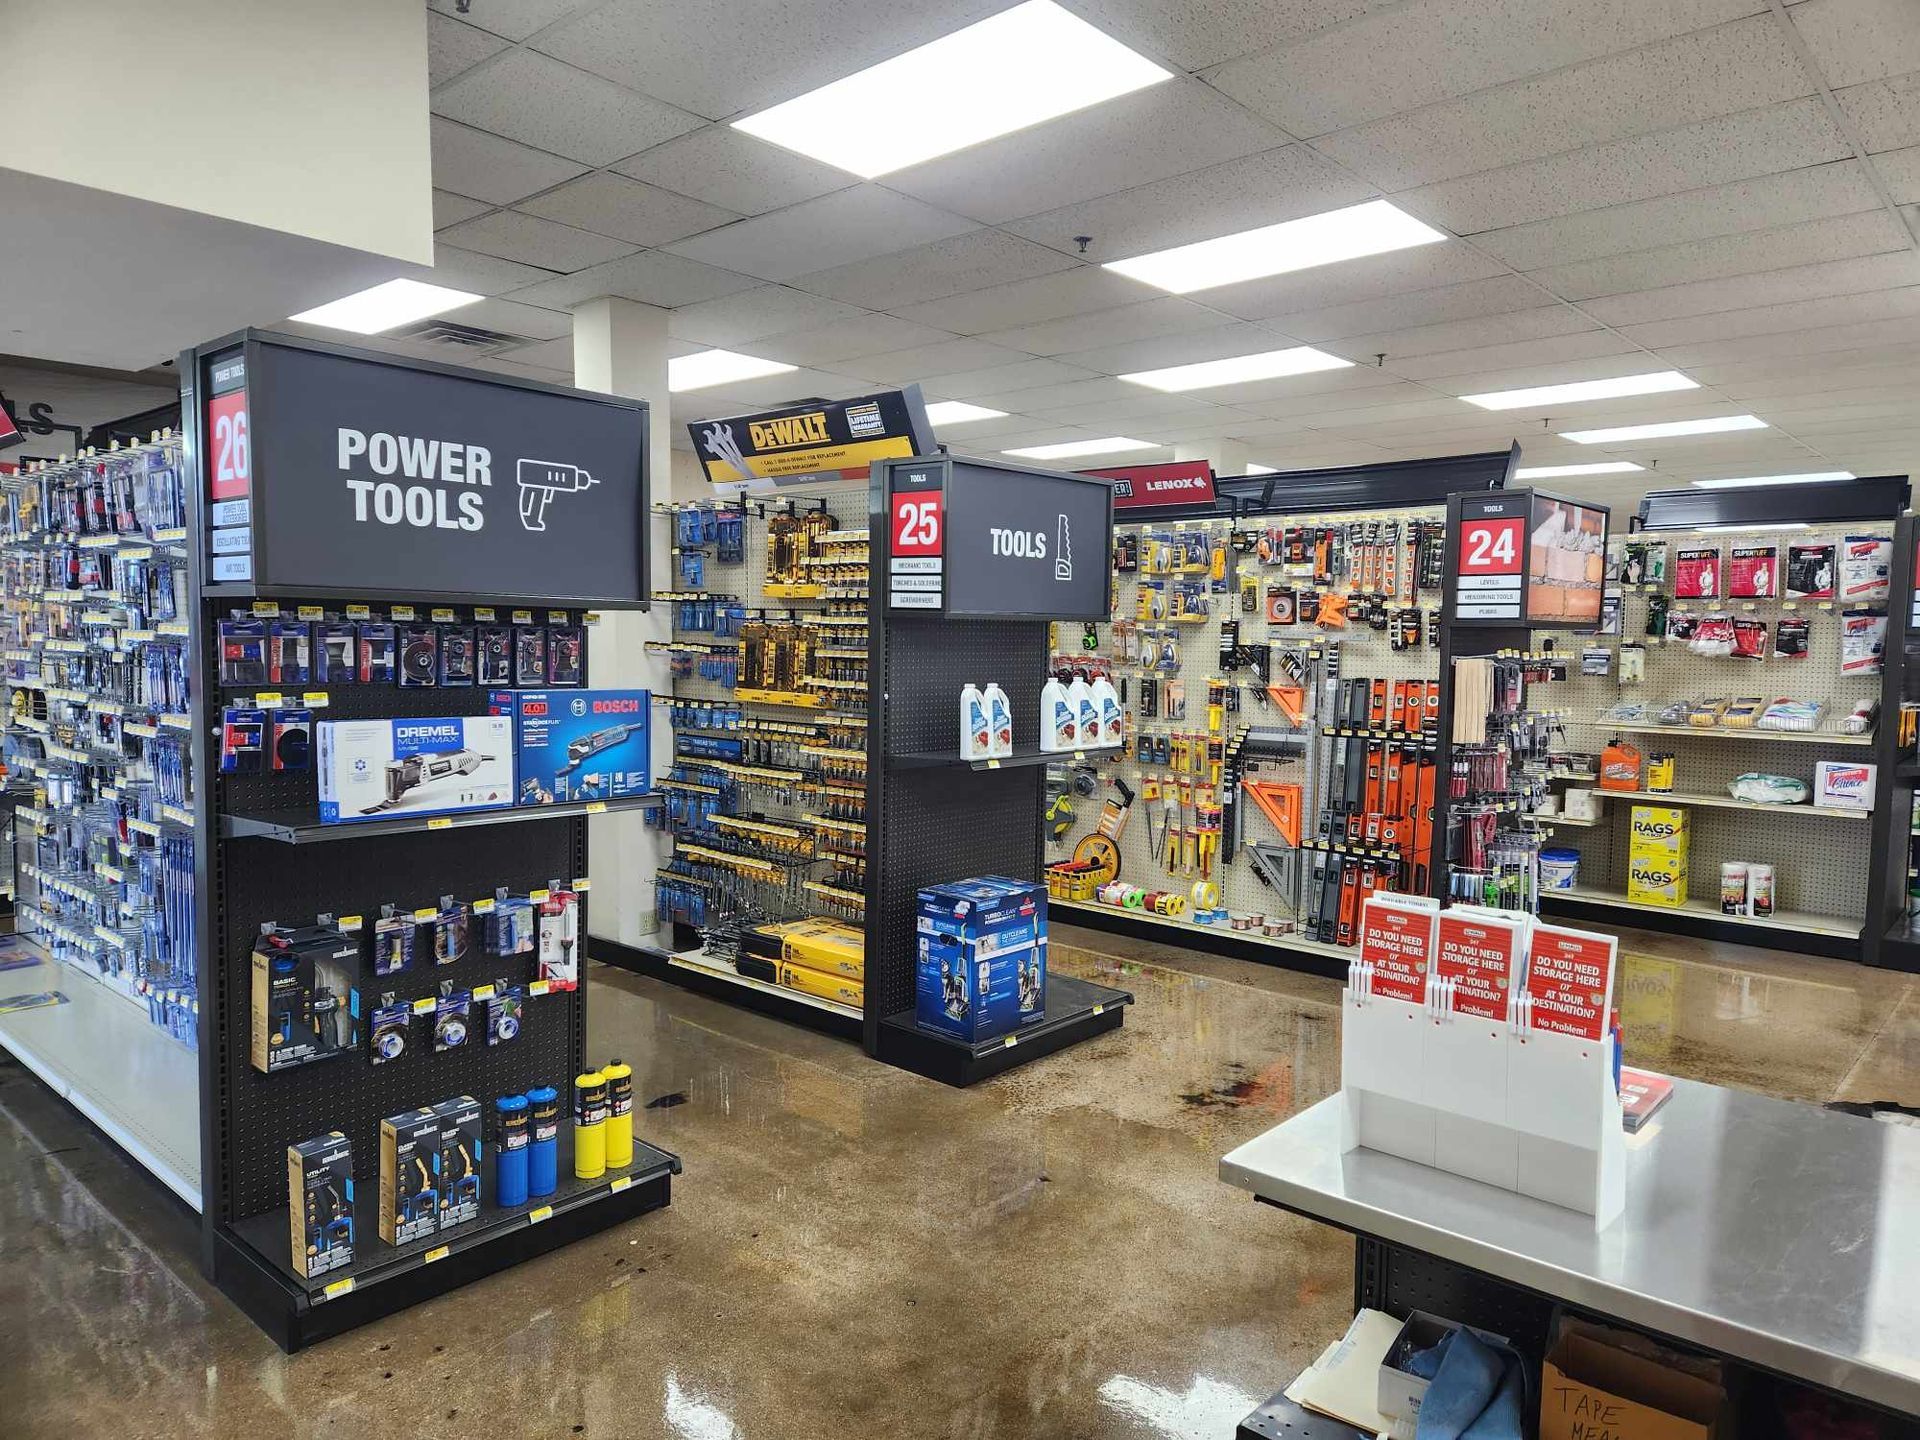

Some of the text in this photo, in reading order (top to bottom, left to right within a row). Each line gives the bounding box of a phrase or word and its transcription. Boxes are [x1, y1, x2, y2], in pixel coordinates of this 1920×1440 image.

[750, 415, 829, 449] DEWALT
[216, 411, 247, 481] 26
[338, 427, 492, 486] POWER
[910, 474, 927, 482] TOOLS
[1146, 479, 1193, 491] LENOX
[1115, 482, 1130, 494] ER!
[346, 479, 484, 532] TOOLS
[1483, 505, 1504, 513] TOOLS
[898, 502, 938, 545] 25
[990, 528, 1047, 559] TOOLS
[1468, 528, 1515, 566] 24
[593, 700, 639, 714] BOSCH
[397, 726, 460, 737] DREMEL
[397, 736, 458, 745] MULTI-MAX
[1633, 821, 1674, 834] RAGS
[1631, 869, 1672, 883] RAGS
[1369, 928, 1380, 938] DO
[1382, 930, 1399, 942] YOU
[1401, 934, 1422, 946] NEED
[1366, 937, 1424, 957] STORAGE HERE
[1444, 941, 1457, 952] DO
[1460, 944, 1478, 956] YOU
[1479, 949, 1503, 961] NEED
[1389, 952, 1399, 960] or
[1442, 951, 1505, 972] STORAGE HERE
[1376, 959, 1410, 974] AT YOUR
[1467, 967, 1478, 976] or
[1536, 955, 1551, 967] DO
[1553, 959, 1572, 971] YOU
[1574, 963, 1599, 976] NEED
[273, 977, 297, 986] BASIC
[1373, 969, 1420, 986] ESTINATION?
[1466, 976, 1490, 989] YOUR
[1533, 966, 1601, 987] STORAGE HERE
[1382, 987, 1413, 1000] Problem!
[1560, 983, 1572, 992] or
[1545, 989, 1584, 1006] AT YOUR
[1460, 1004, 1494, 1018] Problem!
[1533, 997, 1595, 1019] DESTINATION?
[1538, 1018, 1587, 1037] No Problem!
[306, 1165, 331, 1177] UTILITY
[1553, 1387, 1628, 1426] TAPE
[1571, 1421, 1621, 1440] MEA
